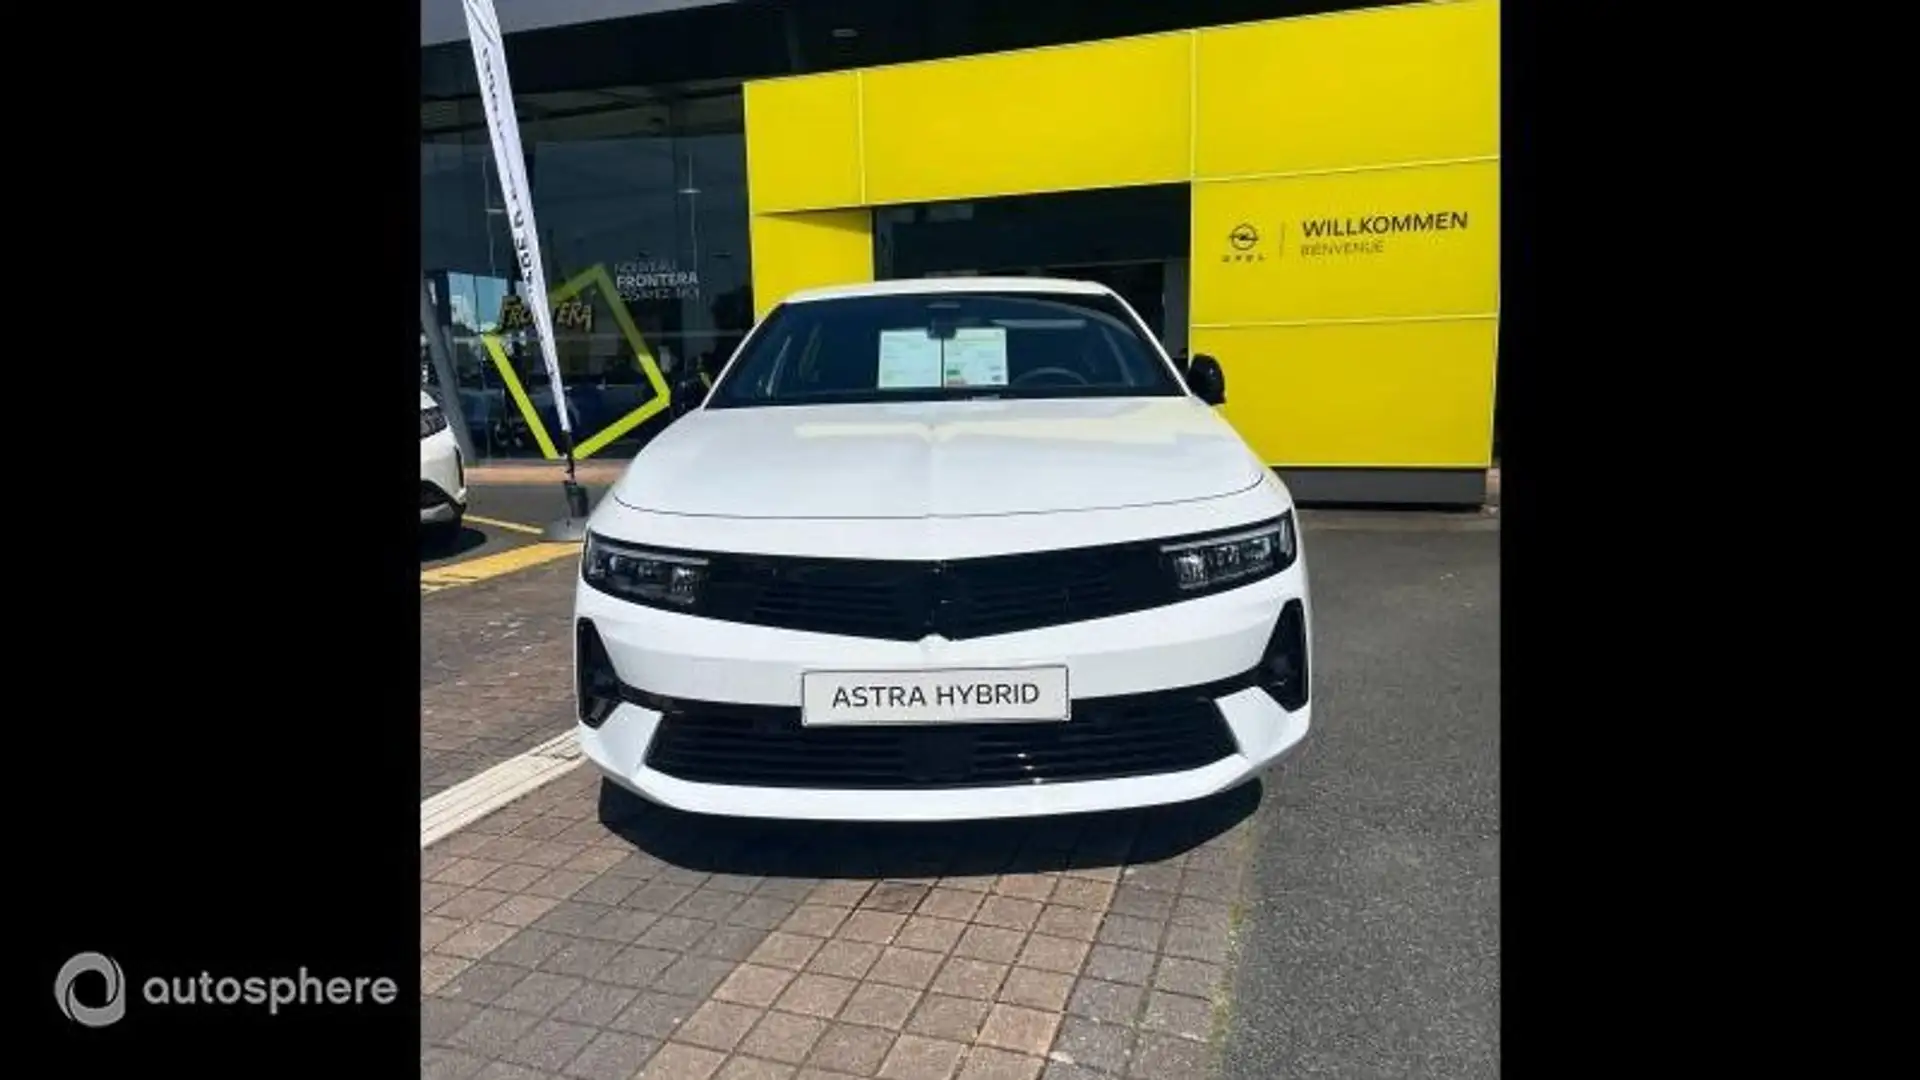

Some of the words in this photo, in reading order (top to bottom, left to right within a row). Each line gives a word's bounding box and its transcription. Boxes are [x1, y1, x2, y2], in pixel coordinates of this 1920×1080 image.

[1302, 211, 1468, 238] WILLKOMMEN
[1300, 239, 1384, 257] BIENVENUE
[616, 271, 699, 289] FRONTERA
[502, 299, 593, 333] FROERA
[832, 685, 927, 708] ASTRA
[936, 682, 1041, 706] HYBRID
